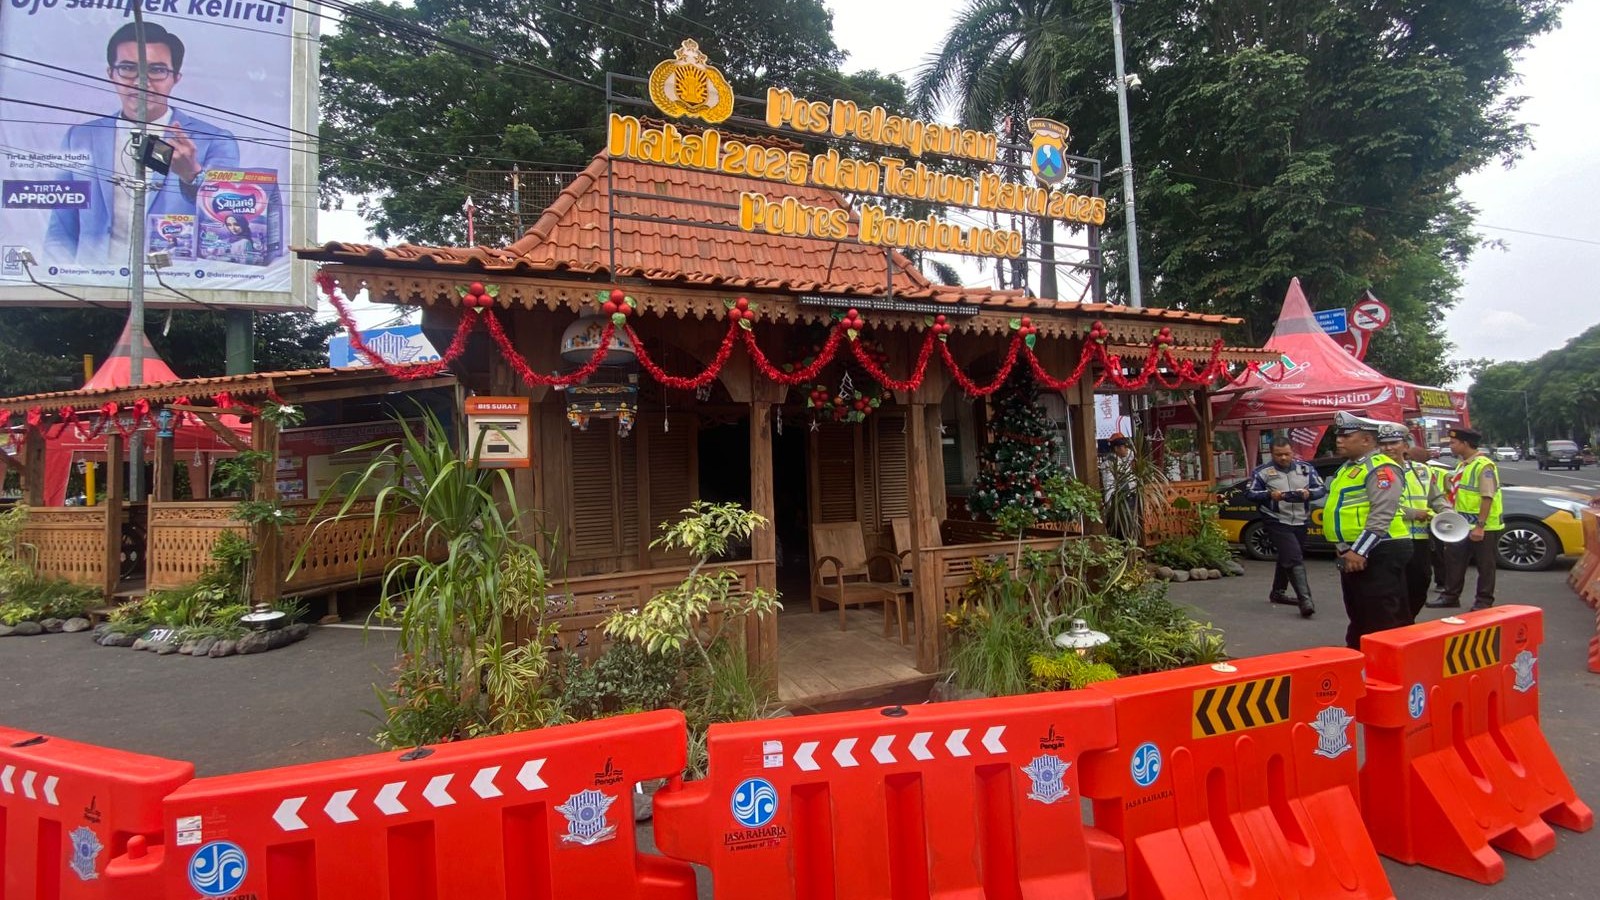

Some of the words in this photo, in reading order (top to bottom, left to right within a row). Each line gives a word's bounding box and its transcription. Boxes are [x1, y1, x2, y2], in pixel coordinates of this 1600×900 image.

[187, 0, 288, 24] keliru!
[766, 87, 830, 133] Pos
[831, 99, 998, 162] Pelayanan
[609, 113, 720, 170] Natal
[721, 141, 810, 186] 2025
[812, 149, 880, 194] dan
[880, 156, 975, 207] Tahun
[979, 170, 1049, 216] Baru
[1048, 191, 1106, 225] 2026
[8, 193, 86, 205] APPROVED
[216, 197, 254, 209] Sayang
[739, 192, 849, 239] Polres
[858, 203, 1023, 257] Bondowoso
[1303, 392, 1371, 406] bankjatim
[1039, 742, 1065, 750] Penguin
[594, 776, 624, 786] Penguin
[1126, 799, 1142, 810] JASA
[725, 831, 745, 845] JASA
[746, 826, 786, 839] RAHARJA
